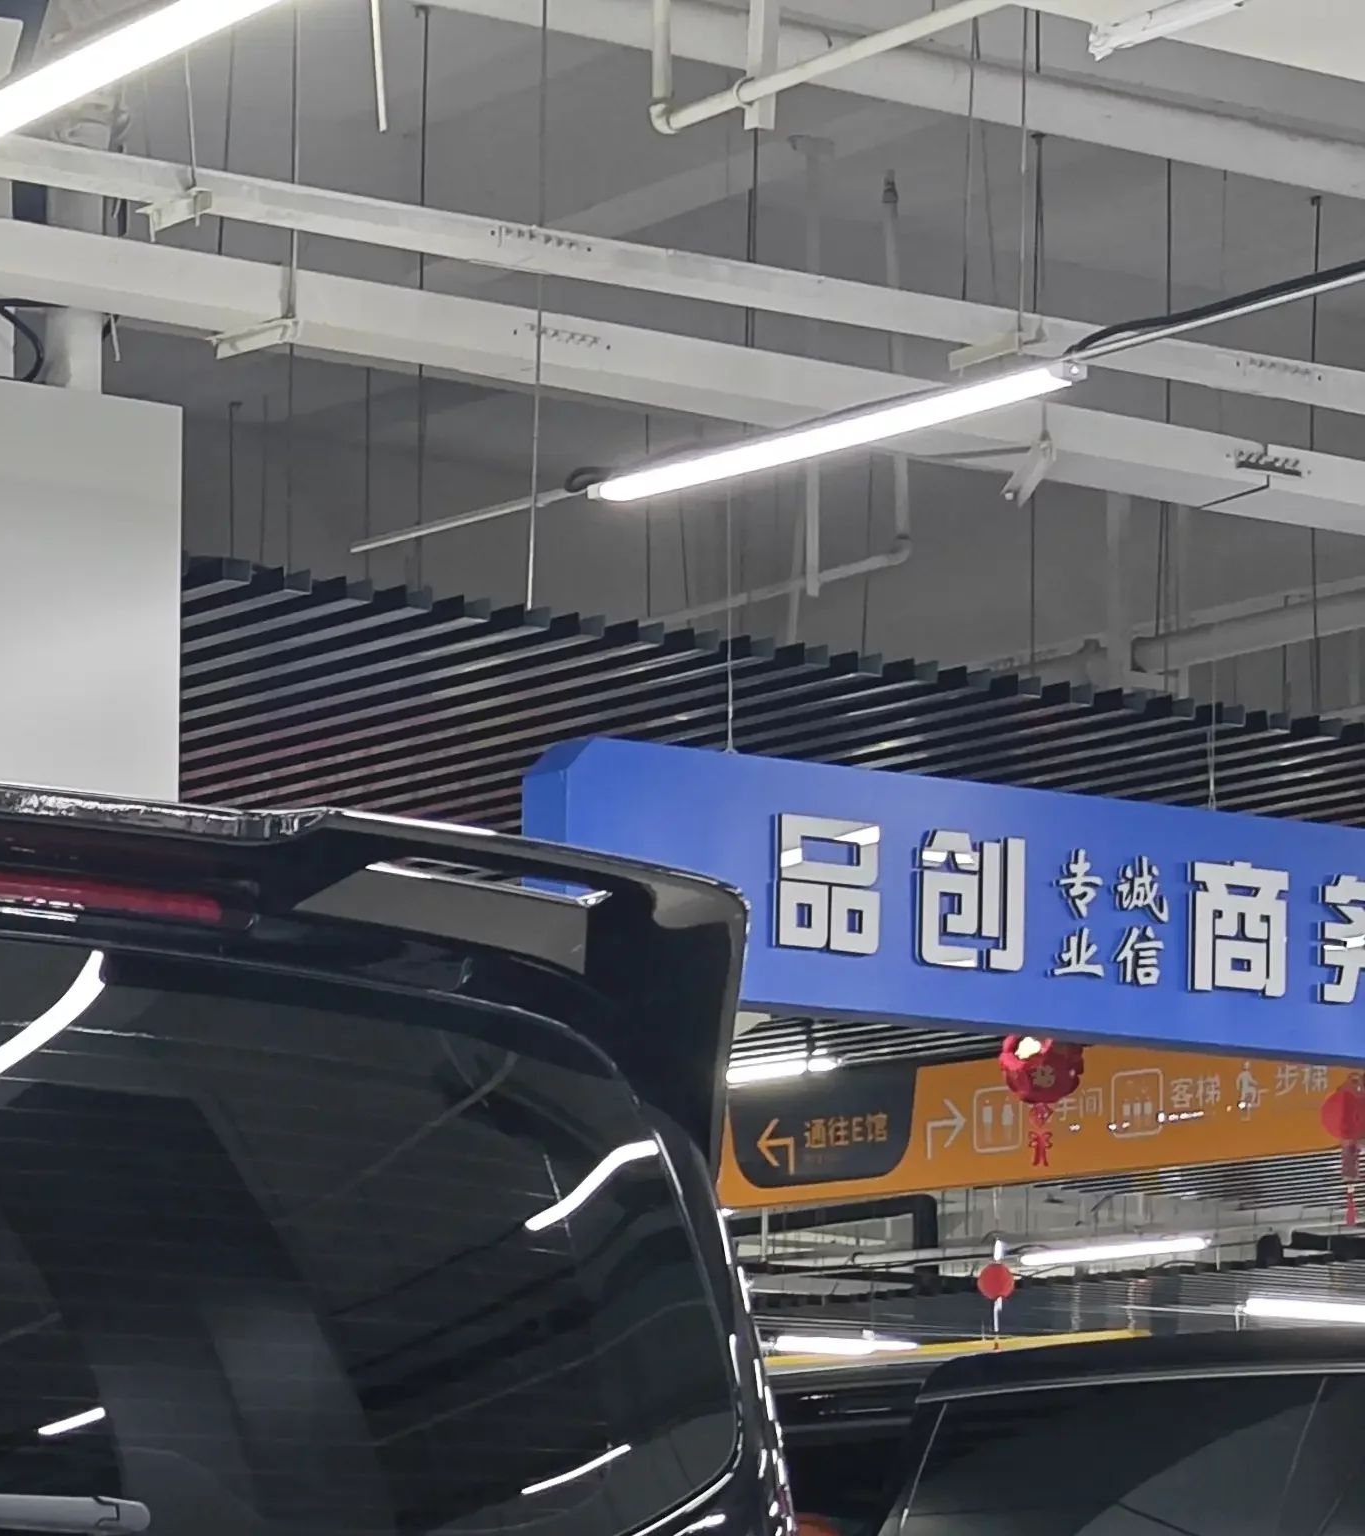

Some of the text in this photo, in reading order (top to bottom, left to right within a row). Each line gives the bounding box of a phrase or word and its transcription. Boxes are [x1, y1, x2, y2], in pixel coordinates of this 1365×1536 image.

[775, 812, 1026, 973] 品创
[804, 1111, 887, 1149] 通往E馆
